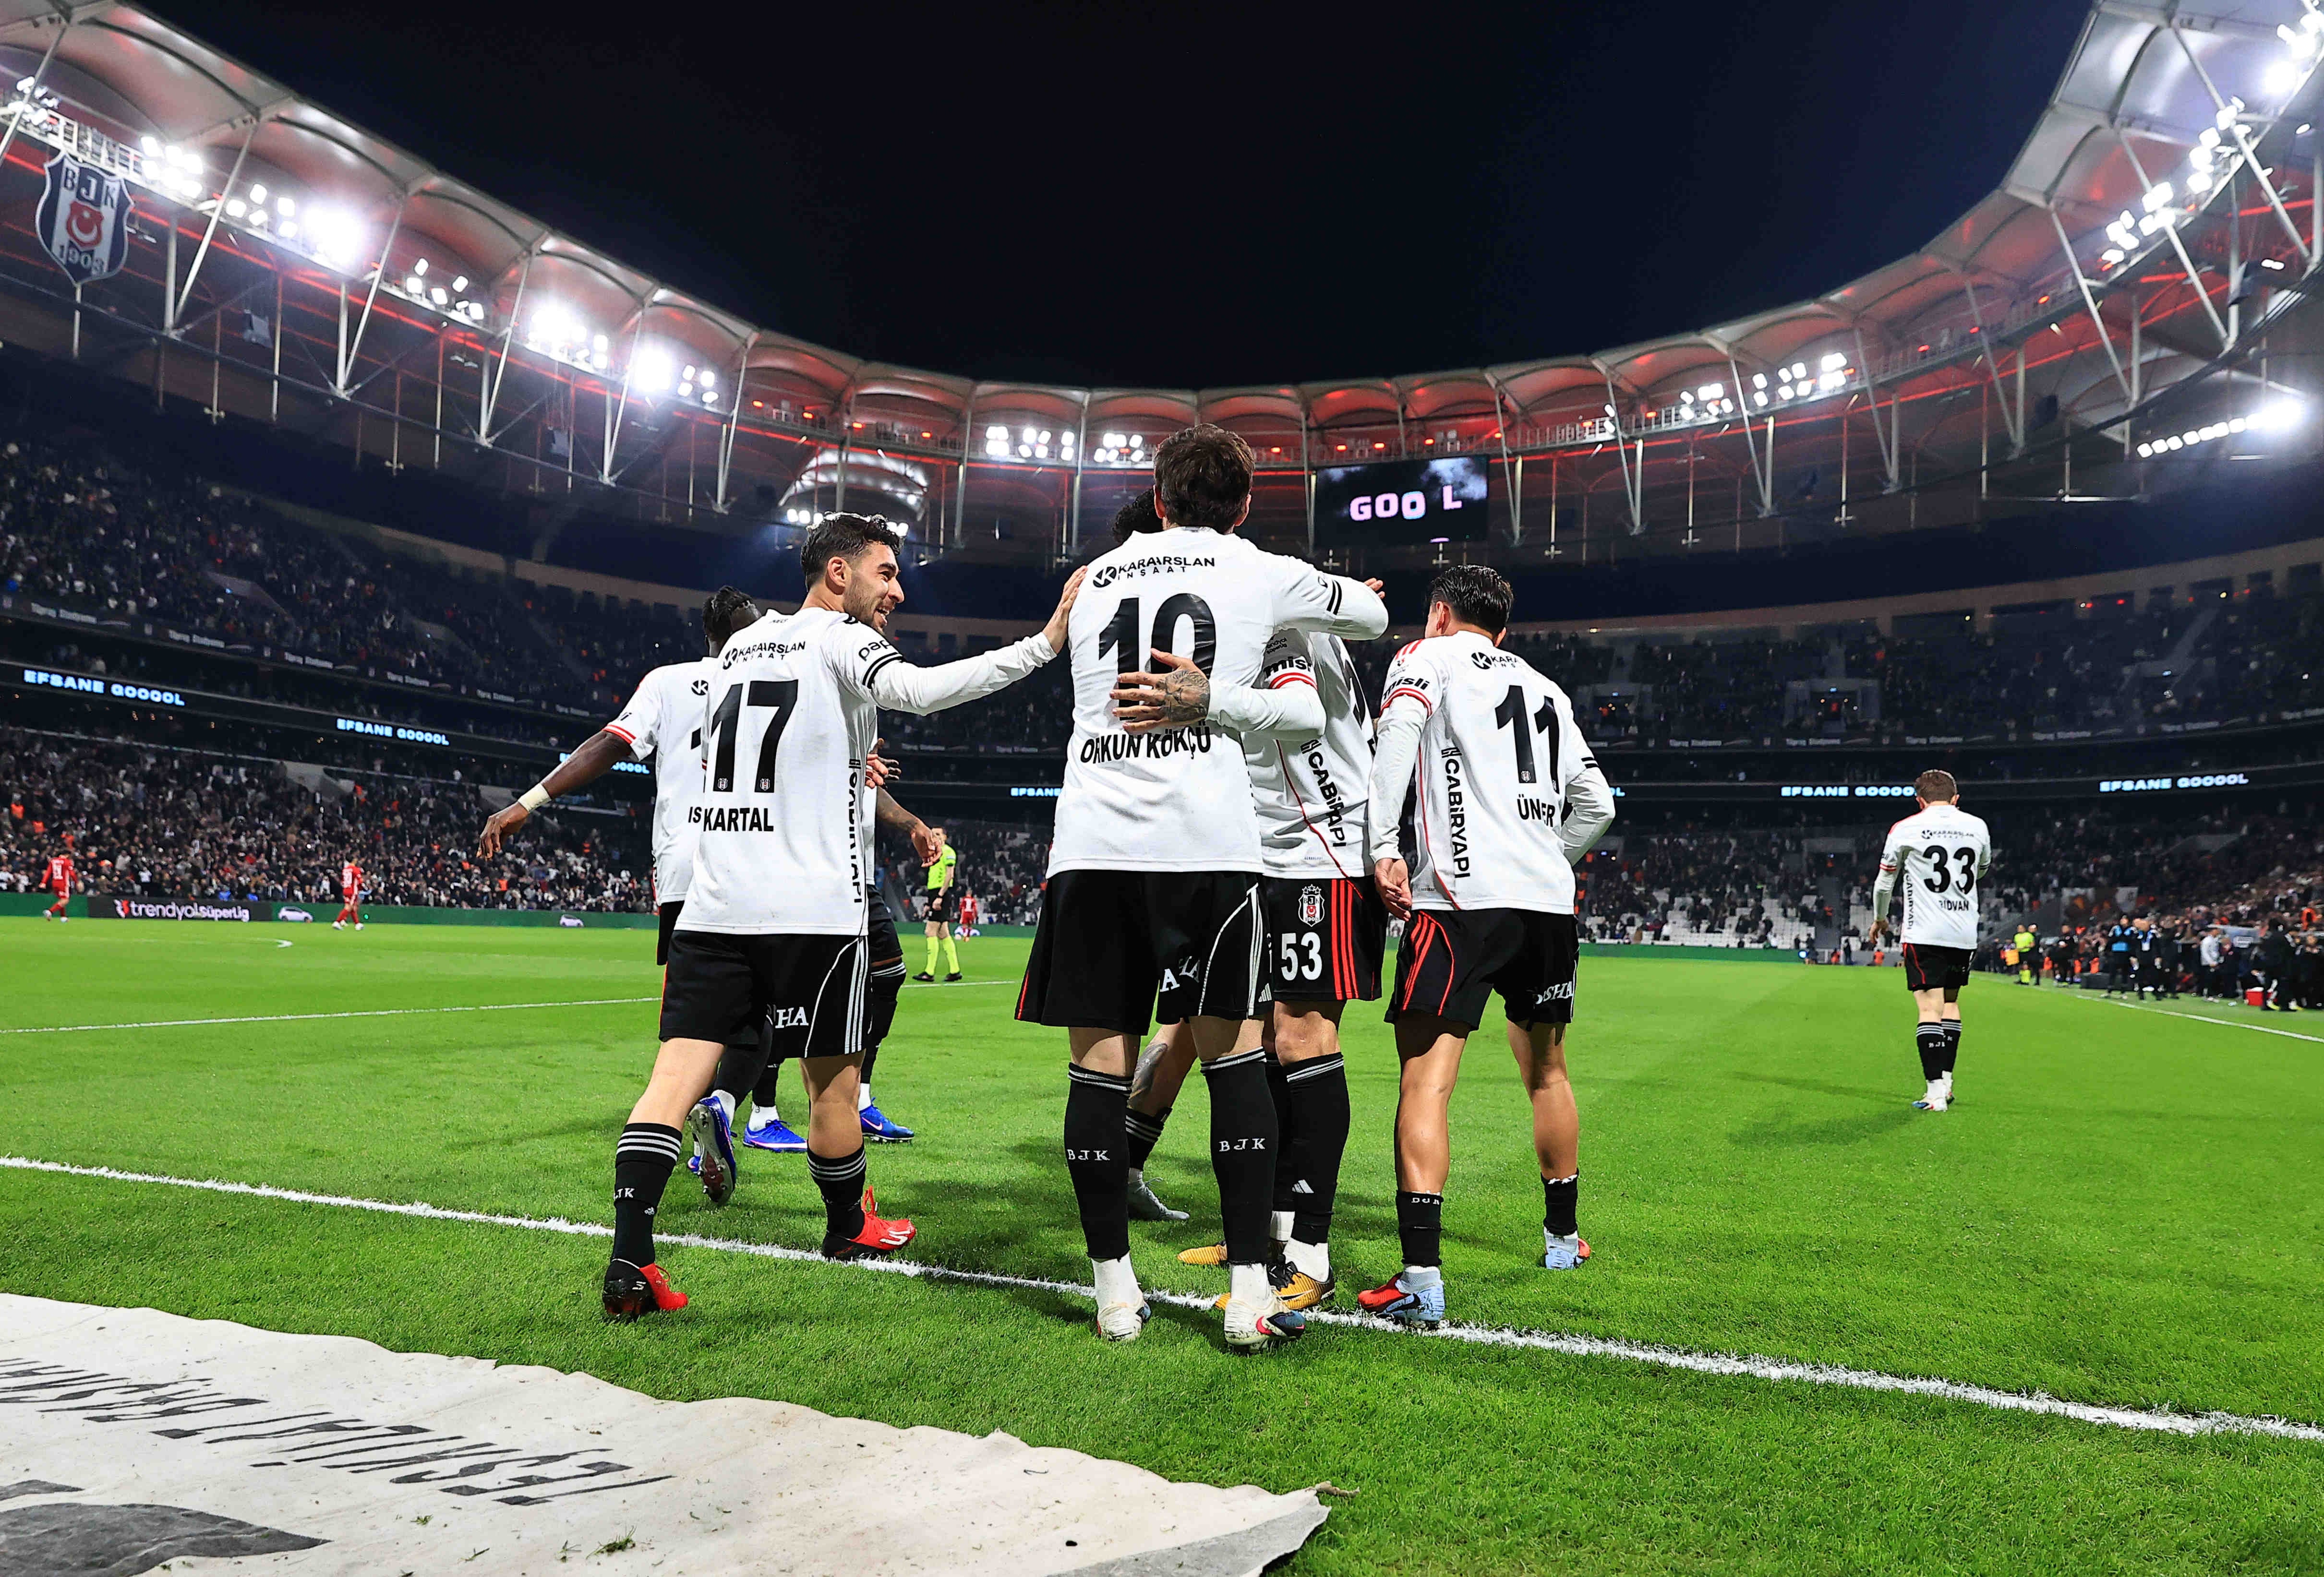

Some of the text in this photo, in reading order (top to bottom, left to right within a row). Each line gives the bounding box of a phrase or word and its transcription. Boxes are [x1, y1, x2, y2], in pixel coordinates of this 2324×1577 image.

[1098, 593, 1216, 721] 10
[24, 670, 185, 706] EFSANE GOOOOL
[1383, 676, 1430, 700] misli
[337, 718, 450, 746] EFSANE GOOOOL
[710, 679, 799, 793] 17
[1080, 720, 1211, 764] ORKUN KÖKÇÜ
[1494, 684, 1560, 795] 11
[1781, 786, 1917, 797] EFSANE GOOOO
[2099, 773, 2249, 792] EFSANE GOOOOL
[703, 808, 774, 832] KARTAL
[1445, 758, 1471, 879] CABİRYAPI
[1923, 845, 1976, 895] 33
[1281, 932, 1323, 981] 53
[1067, 1149, 1110, 1161] BJK
[1219, 1138, 1265, 1152] BJK
